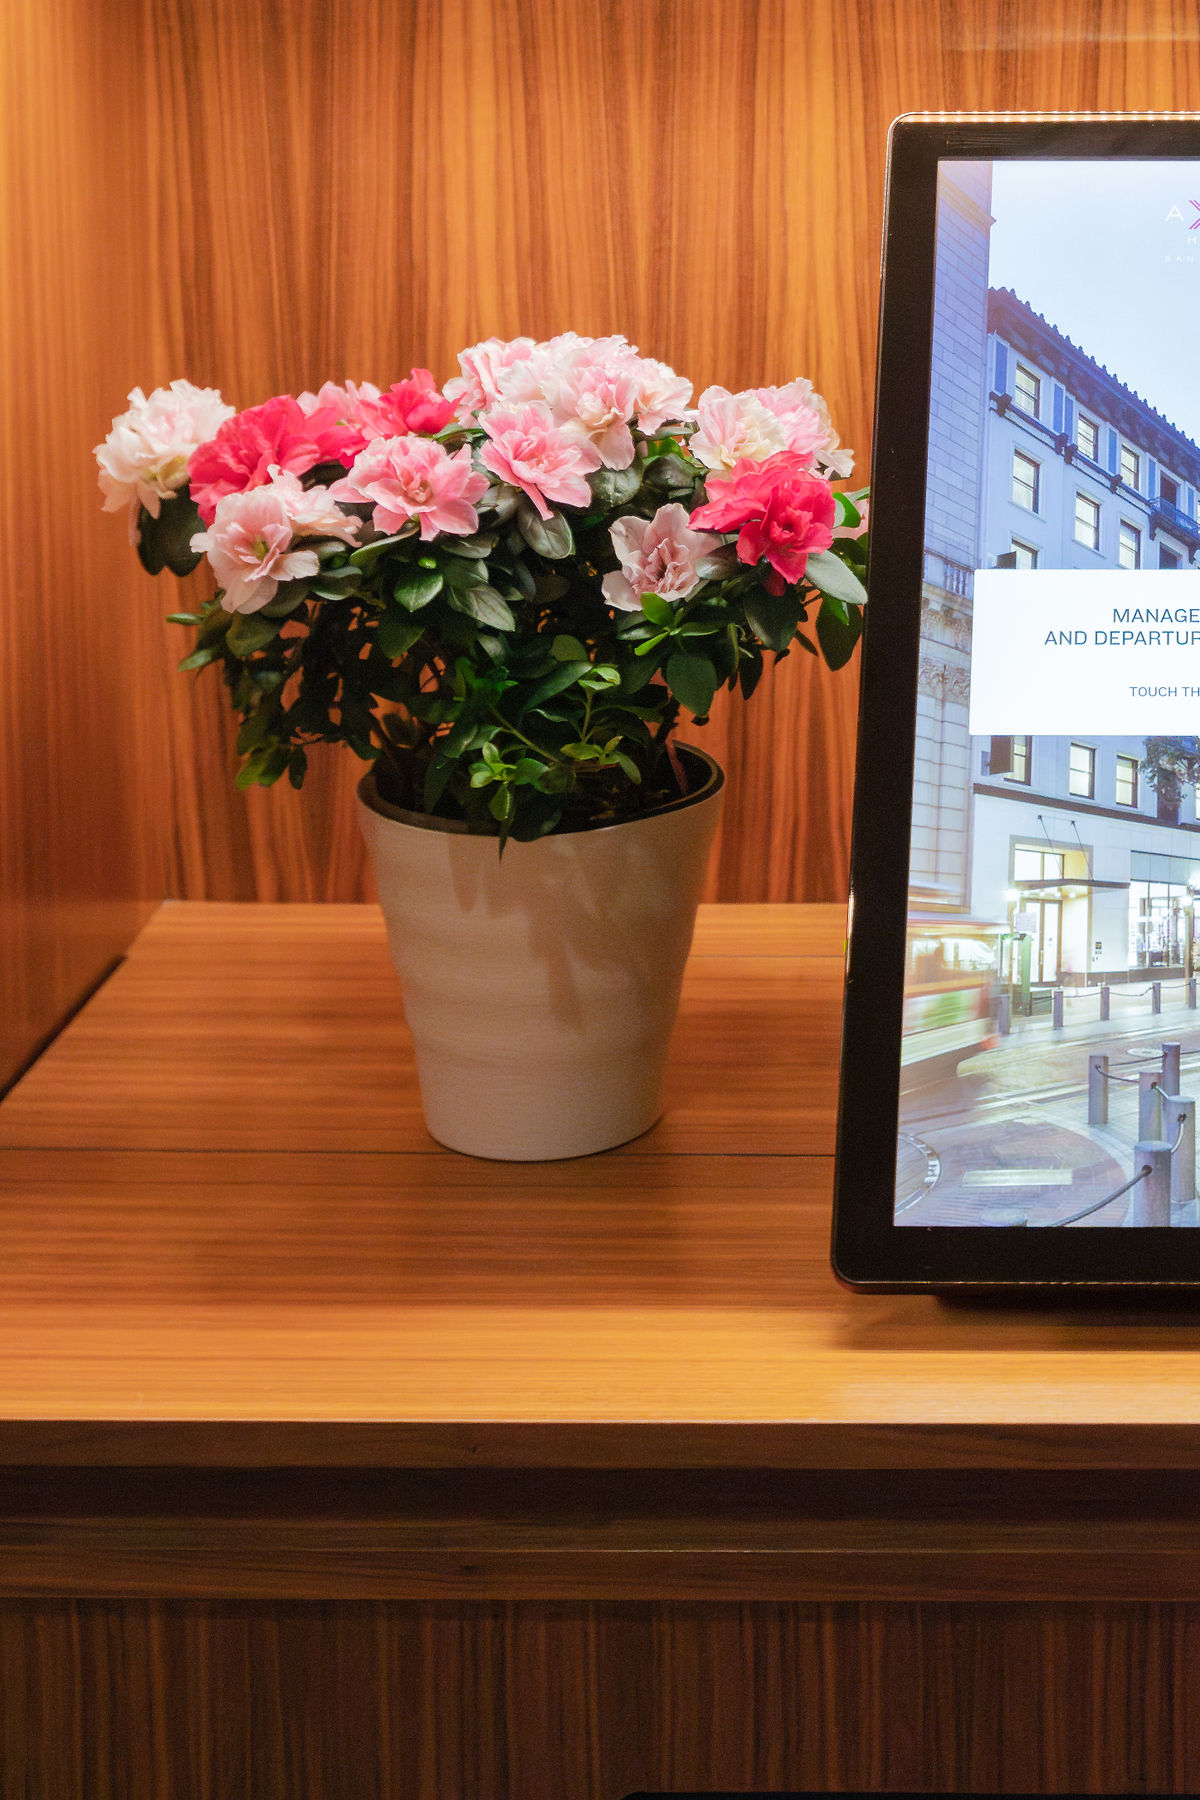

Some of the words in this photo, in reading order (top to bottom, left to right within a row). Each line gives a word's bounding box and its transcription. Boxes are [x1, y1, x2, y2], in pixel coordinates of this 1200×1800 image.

[1112, 608, 1200, 623] MANAGE
[1044, 631, 1088, 646] AND
[1129, 686, 1178, 698] TOUCH
